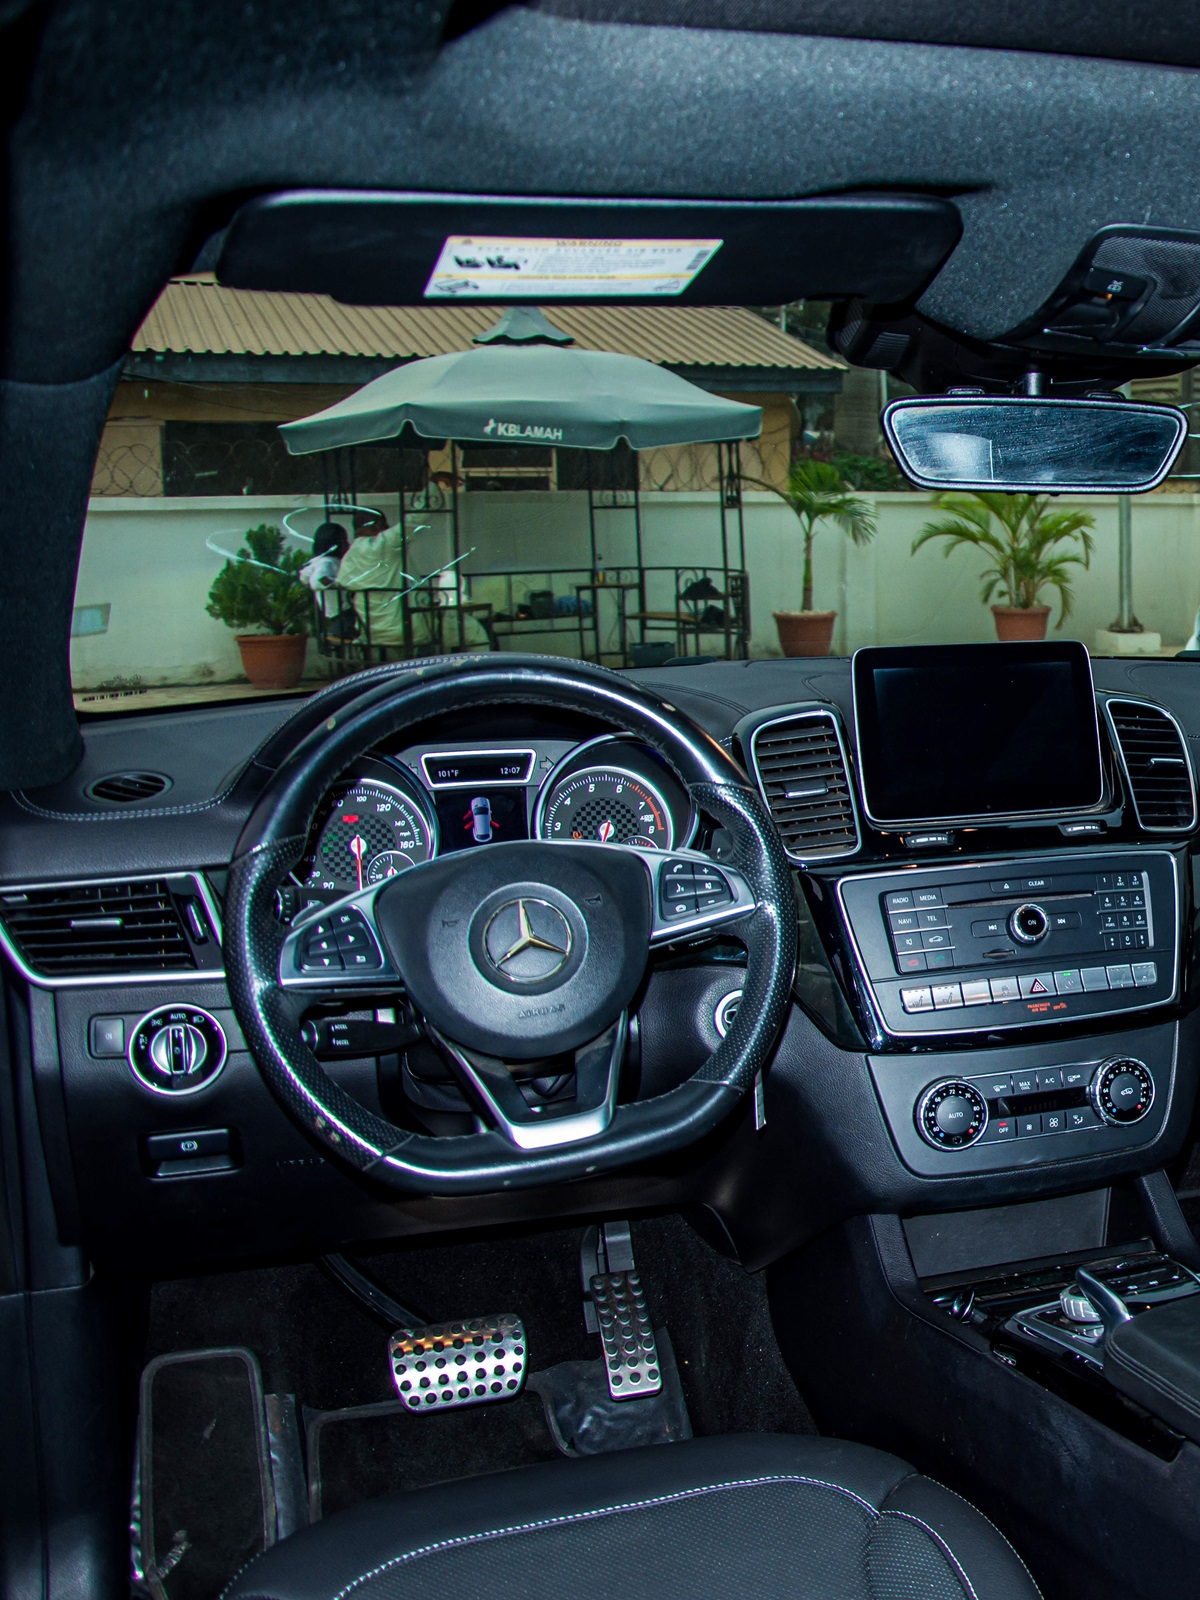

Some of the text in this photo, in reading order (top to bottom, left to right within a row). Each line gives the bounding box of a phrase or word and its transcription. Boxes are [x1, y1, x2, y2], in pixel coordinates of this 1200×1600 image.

[500, 766, 520, 775] 12:07
[588, 783, 596, 793] 5
[616, 784, 623, 793] 6
[564, 797, 571, 806] 4
[638, 801, 646, 810] 7
[376, 803, 391, 812] 120
[554, 822, 561, 831] 3
[648, 825, 655, 834] 8
[400, 841, 415, 849] 160
[340, 915, 350, 923] OK
